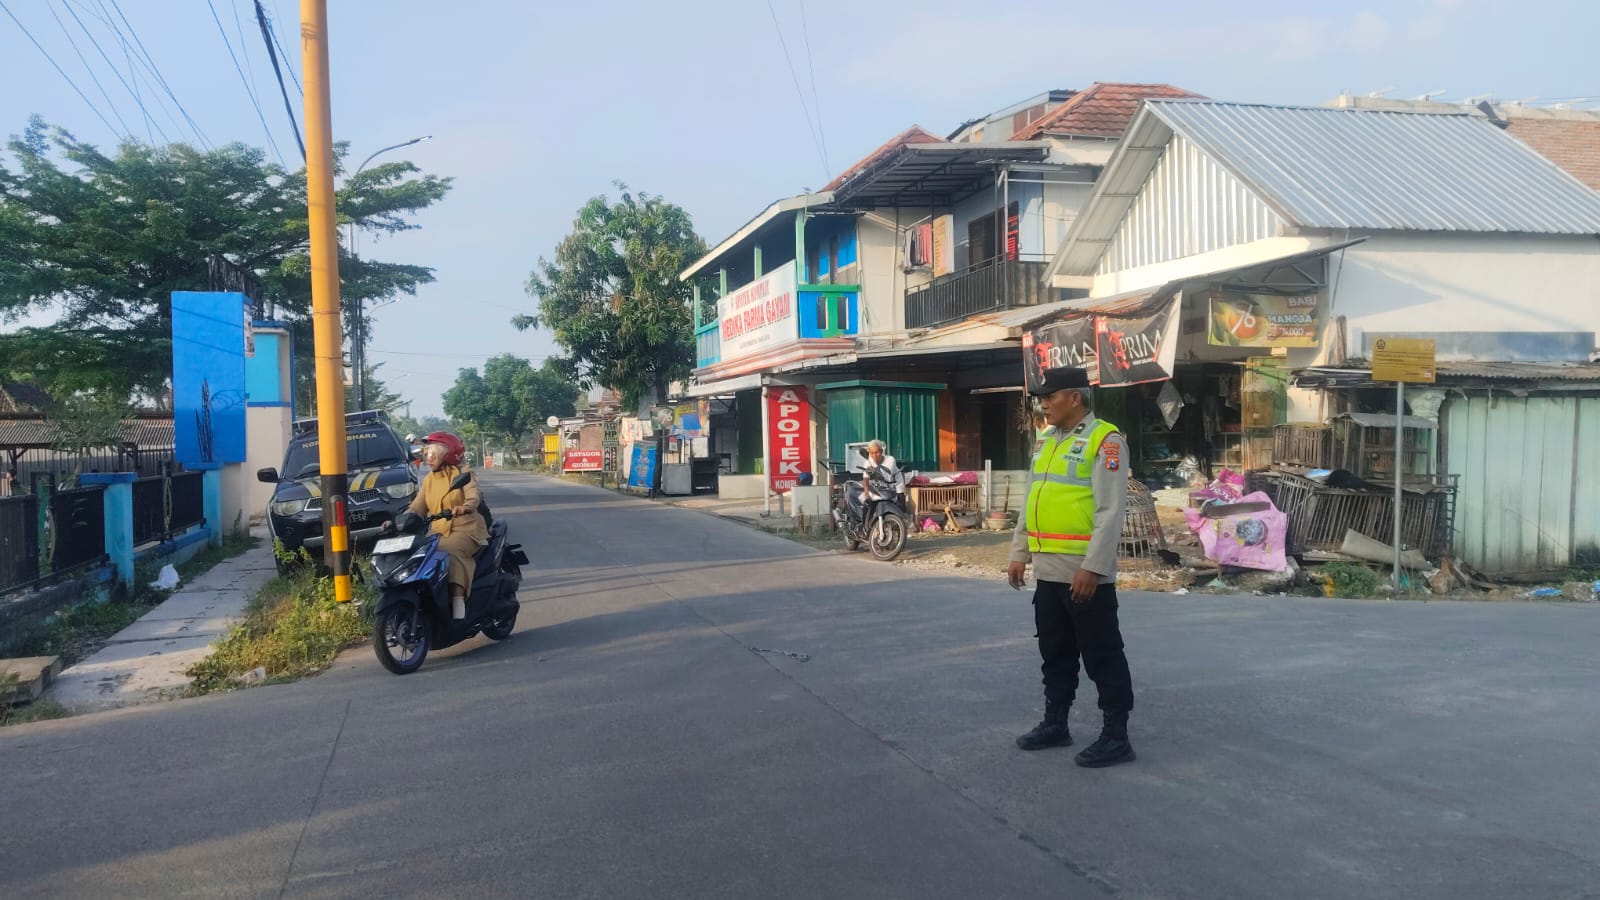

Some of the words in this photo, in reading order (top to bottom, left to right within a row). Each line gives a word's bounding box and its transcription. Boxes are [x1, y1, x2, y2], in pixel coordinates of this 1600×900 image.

[722, 313, 744, 341] MEDIKA
[743, 304, 766, 331] FARMA
[765, 291, 791, 322] GAYAM
[1267, 314, 1313, 324] MANGGA
[777, 390, 801, 475] APOTEK
